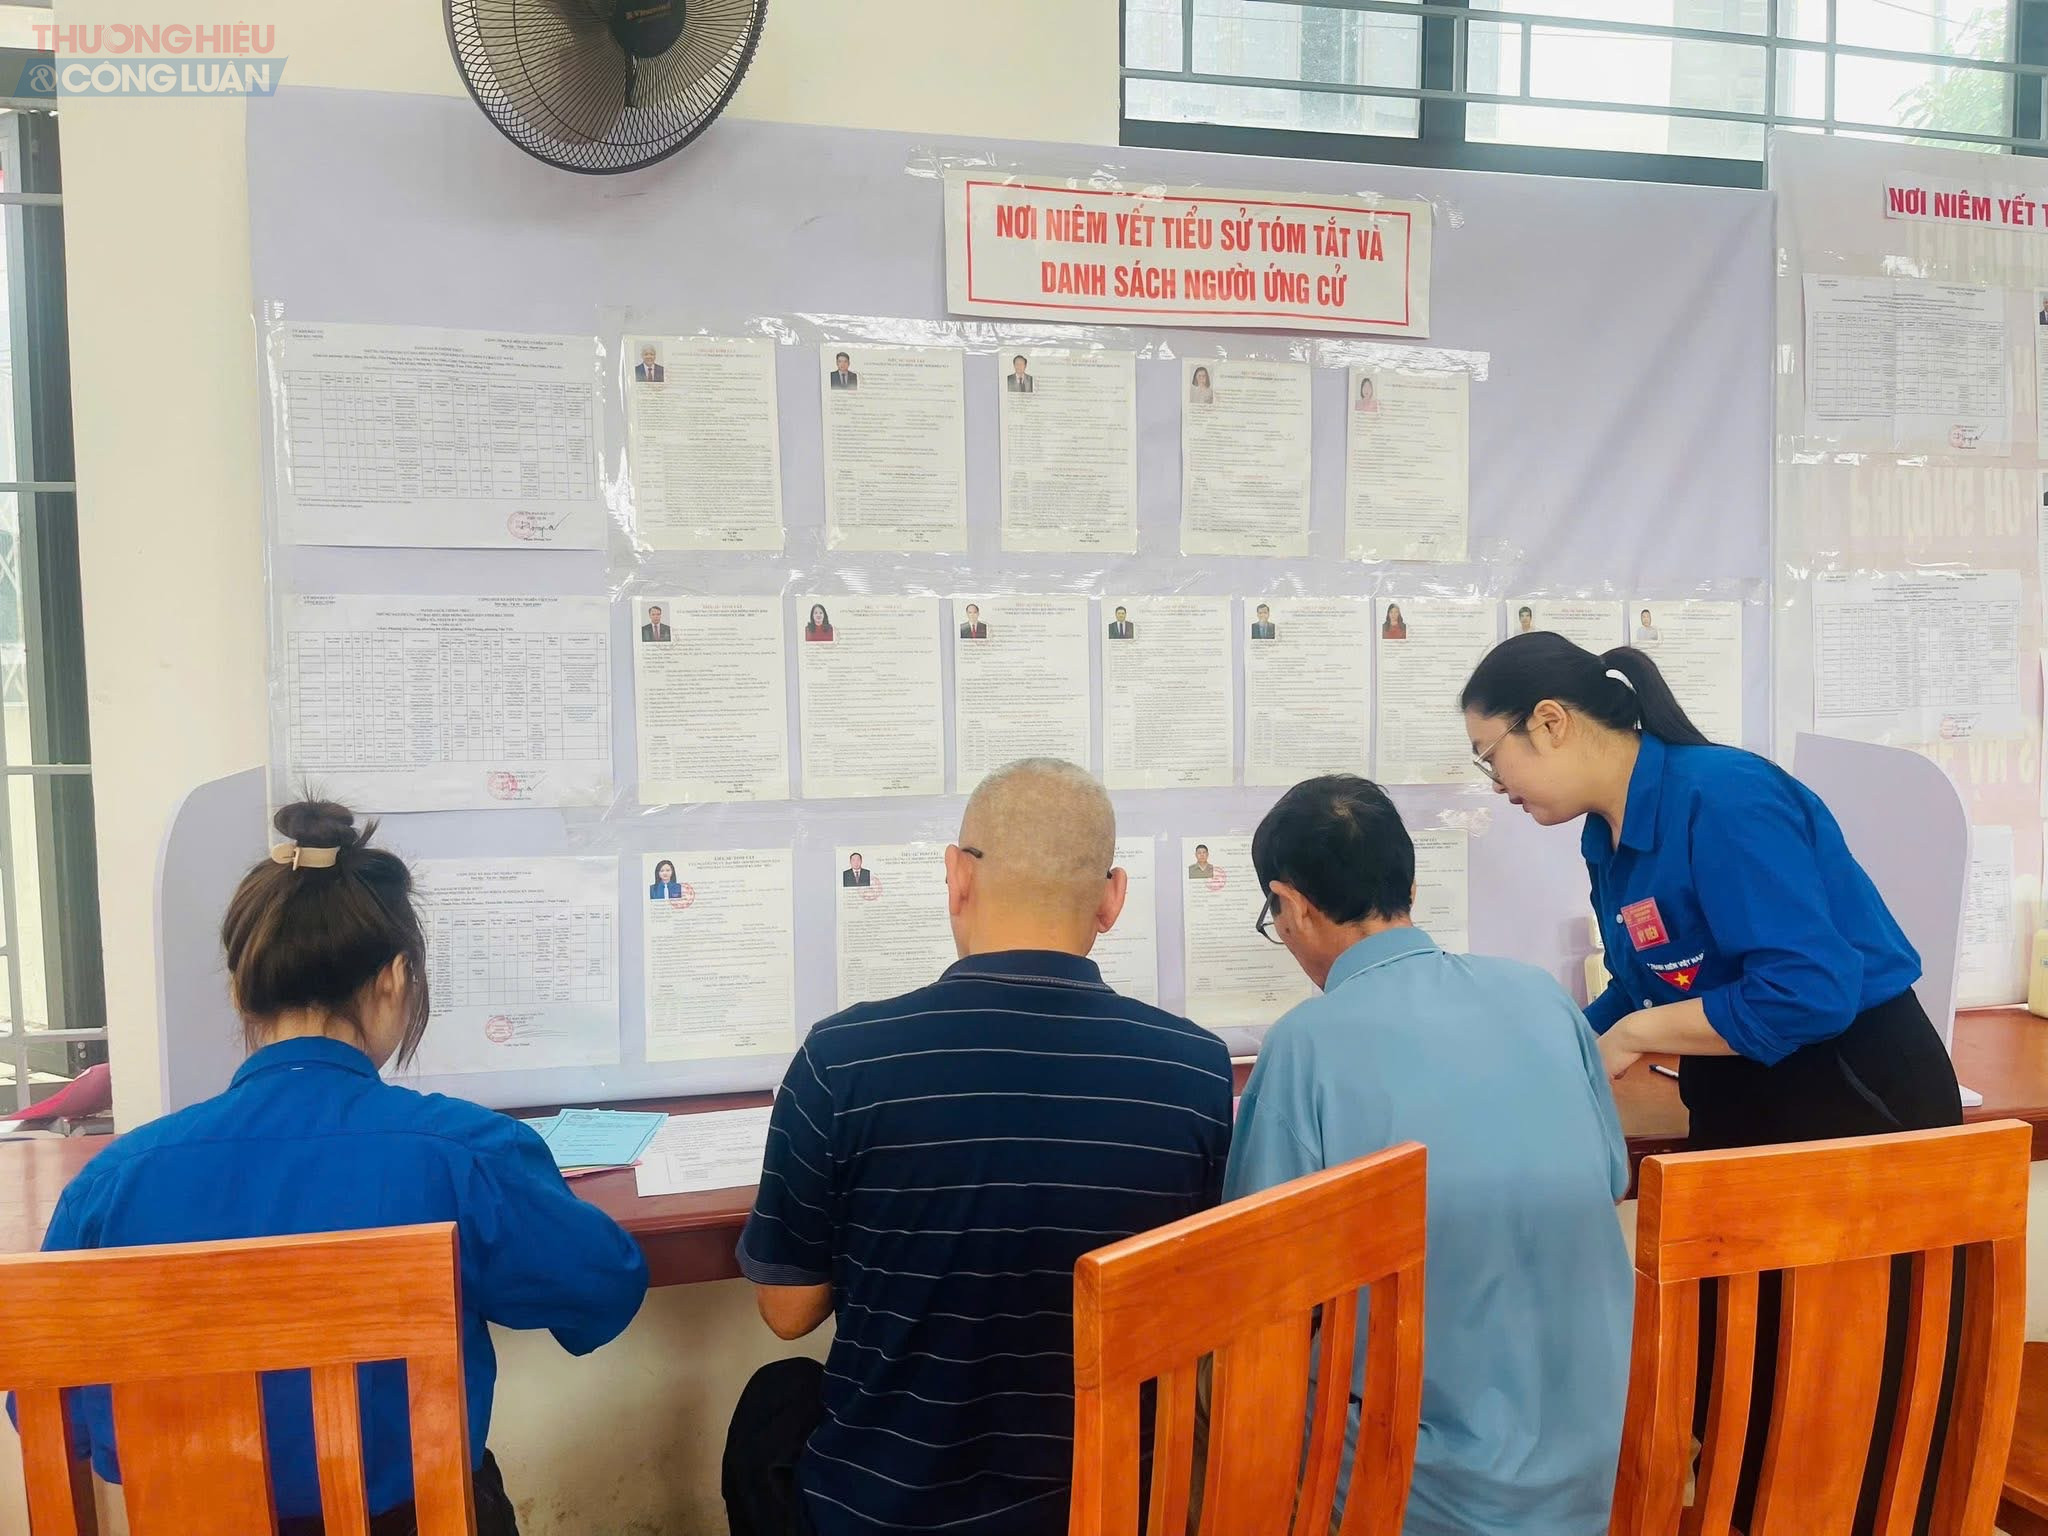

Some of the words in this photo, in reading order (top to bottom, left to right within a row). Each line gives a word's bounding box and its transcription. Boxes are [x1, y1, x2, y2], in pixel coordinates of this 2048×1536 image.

[1888, 187, 1927, 216] NƠI
[1934, 190, 1992, 222] NIÊM
[1998, 193, 2036, 227] YẾT
[995, 204, 1037, 241] NƠI
[1045, 203, 1108, 245] NIÊM
[1115, 203, 1155, 249] YẾT
[1162, 204, 1213, 250] TIỂU
[1220, 207, 1255, 253] SỬ
[1257, 214, 1307, 255] TÓM
[1313, 216, 1351, 259] TẮT
[1356, 227, 1384, 262] VÀ
[1040, 261, 1107, 297] DANH
[1114, 260, 1177, 300] SÁCH
[1184, 262, 1256, 302] NGƯỜI
[1263, 262, 1310, 305] ỨNG
[1316, 264, 1349, 308] CỬ
